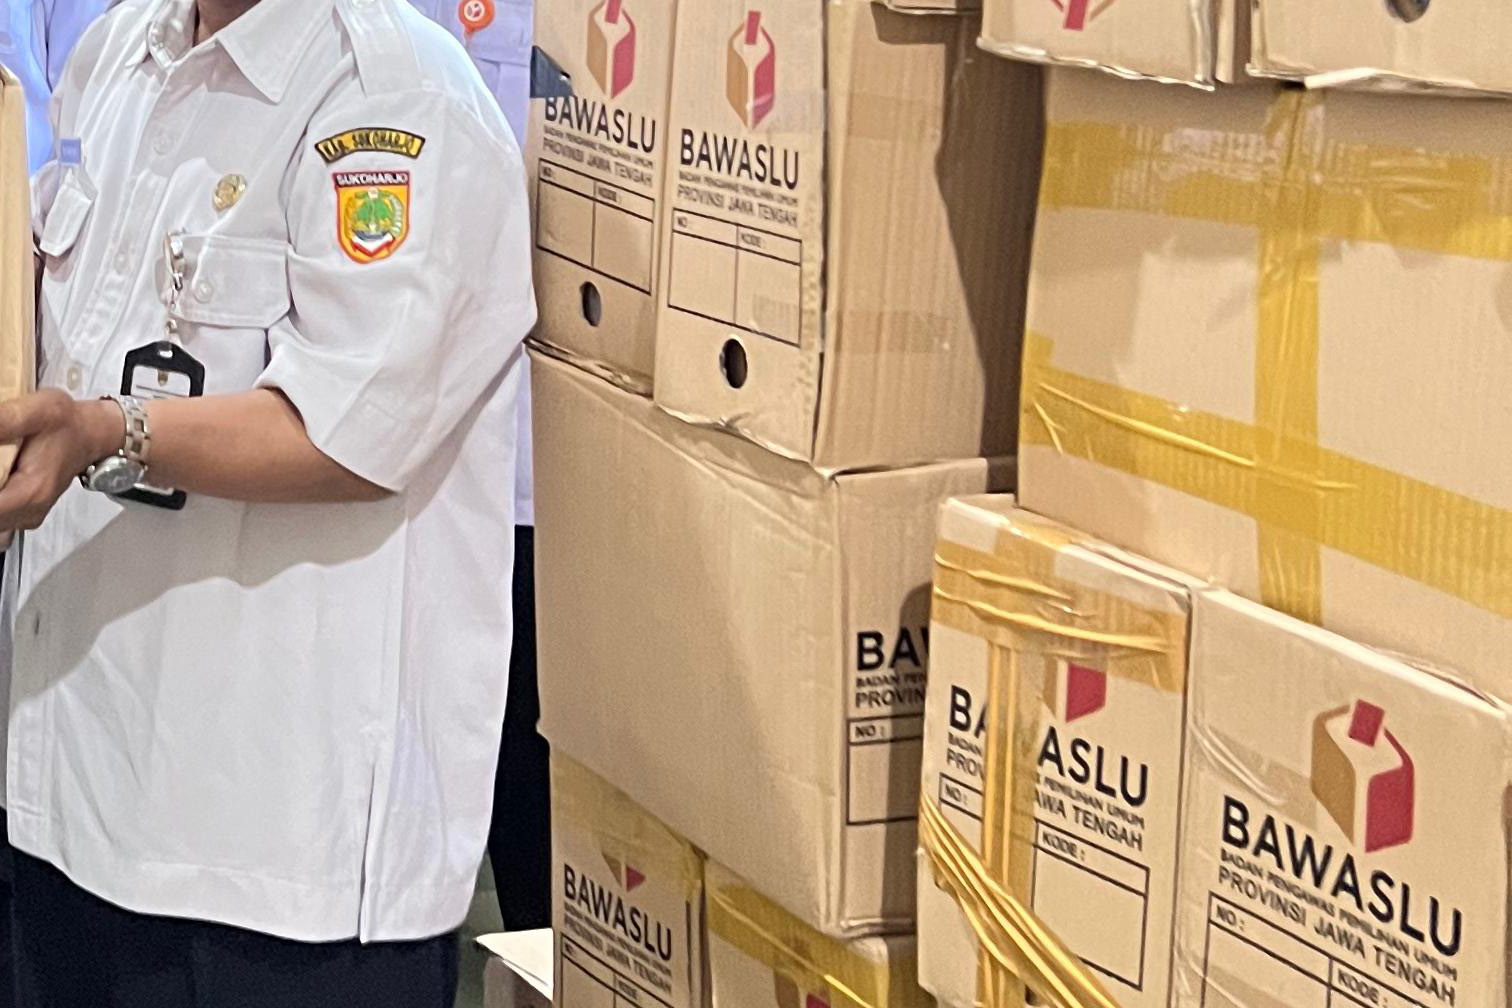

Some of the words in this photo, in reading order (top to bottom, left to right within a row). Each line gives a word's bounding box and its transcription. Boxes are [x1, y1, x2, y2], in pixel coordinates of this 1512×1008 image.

[544, 95, 656, 154] BAWASLU
[335, 172, 409, 186] SUKOHARJO
[679, 127, 799, 191] BAWASLU
[1071, 804, 1143, 852] TENGAH
[1222, 794, 1463, 957] BAWASLU
[564, 862, 672, 962] BAWASLU
[1218, 864, 1307, 928] PROVINSI
[1313, 915, 1366, 960] JAWA
[1373, 944, 1456, 1008] TENGAH
